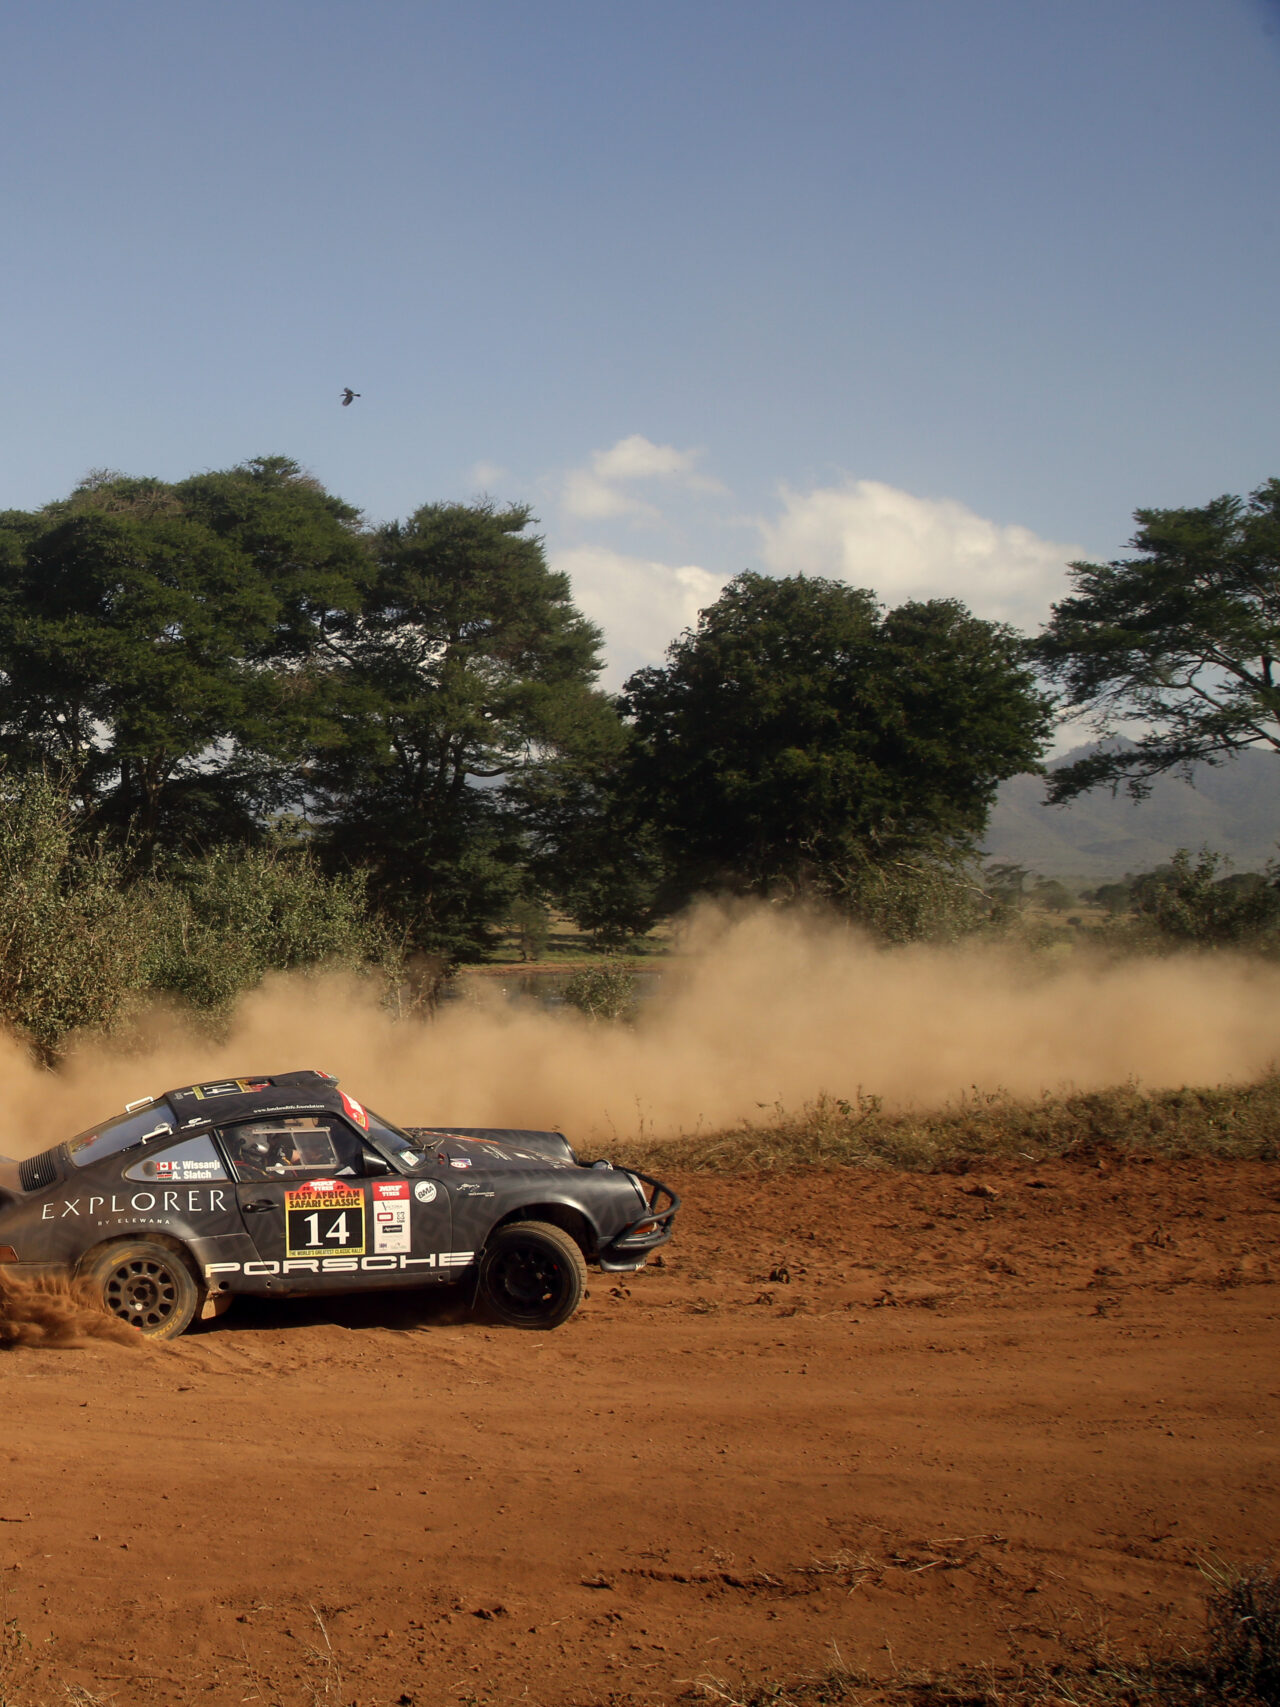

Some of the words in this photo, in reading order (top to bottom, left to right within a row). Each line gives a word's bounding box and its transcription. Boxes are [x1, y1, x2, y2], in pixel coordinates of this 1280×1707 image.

[172, 1161, 181, 1170] K.
[172, 1171, 181, 1180] A.
[183, 1170, 212, 1179] Slatch
[289, 1192, 312, 1201] EAST
[315, 1190, 360, 1200] AFRICAN
[418, 1185, 434, 1199] BMA
[41, 1190, 227, 1220] EXPLORER
[289, 1199, 321, 1209] SAFARI
[323, 1198, 361, 1208] CLASSIC
[303, 1211, 350, 1247] 14
[205, 1251, 475, 1278] PORSCHE
